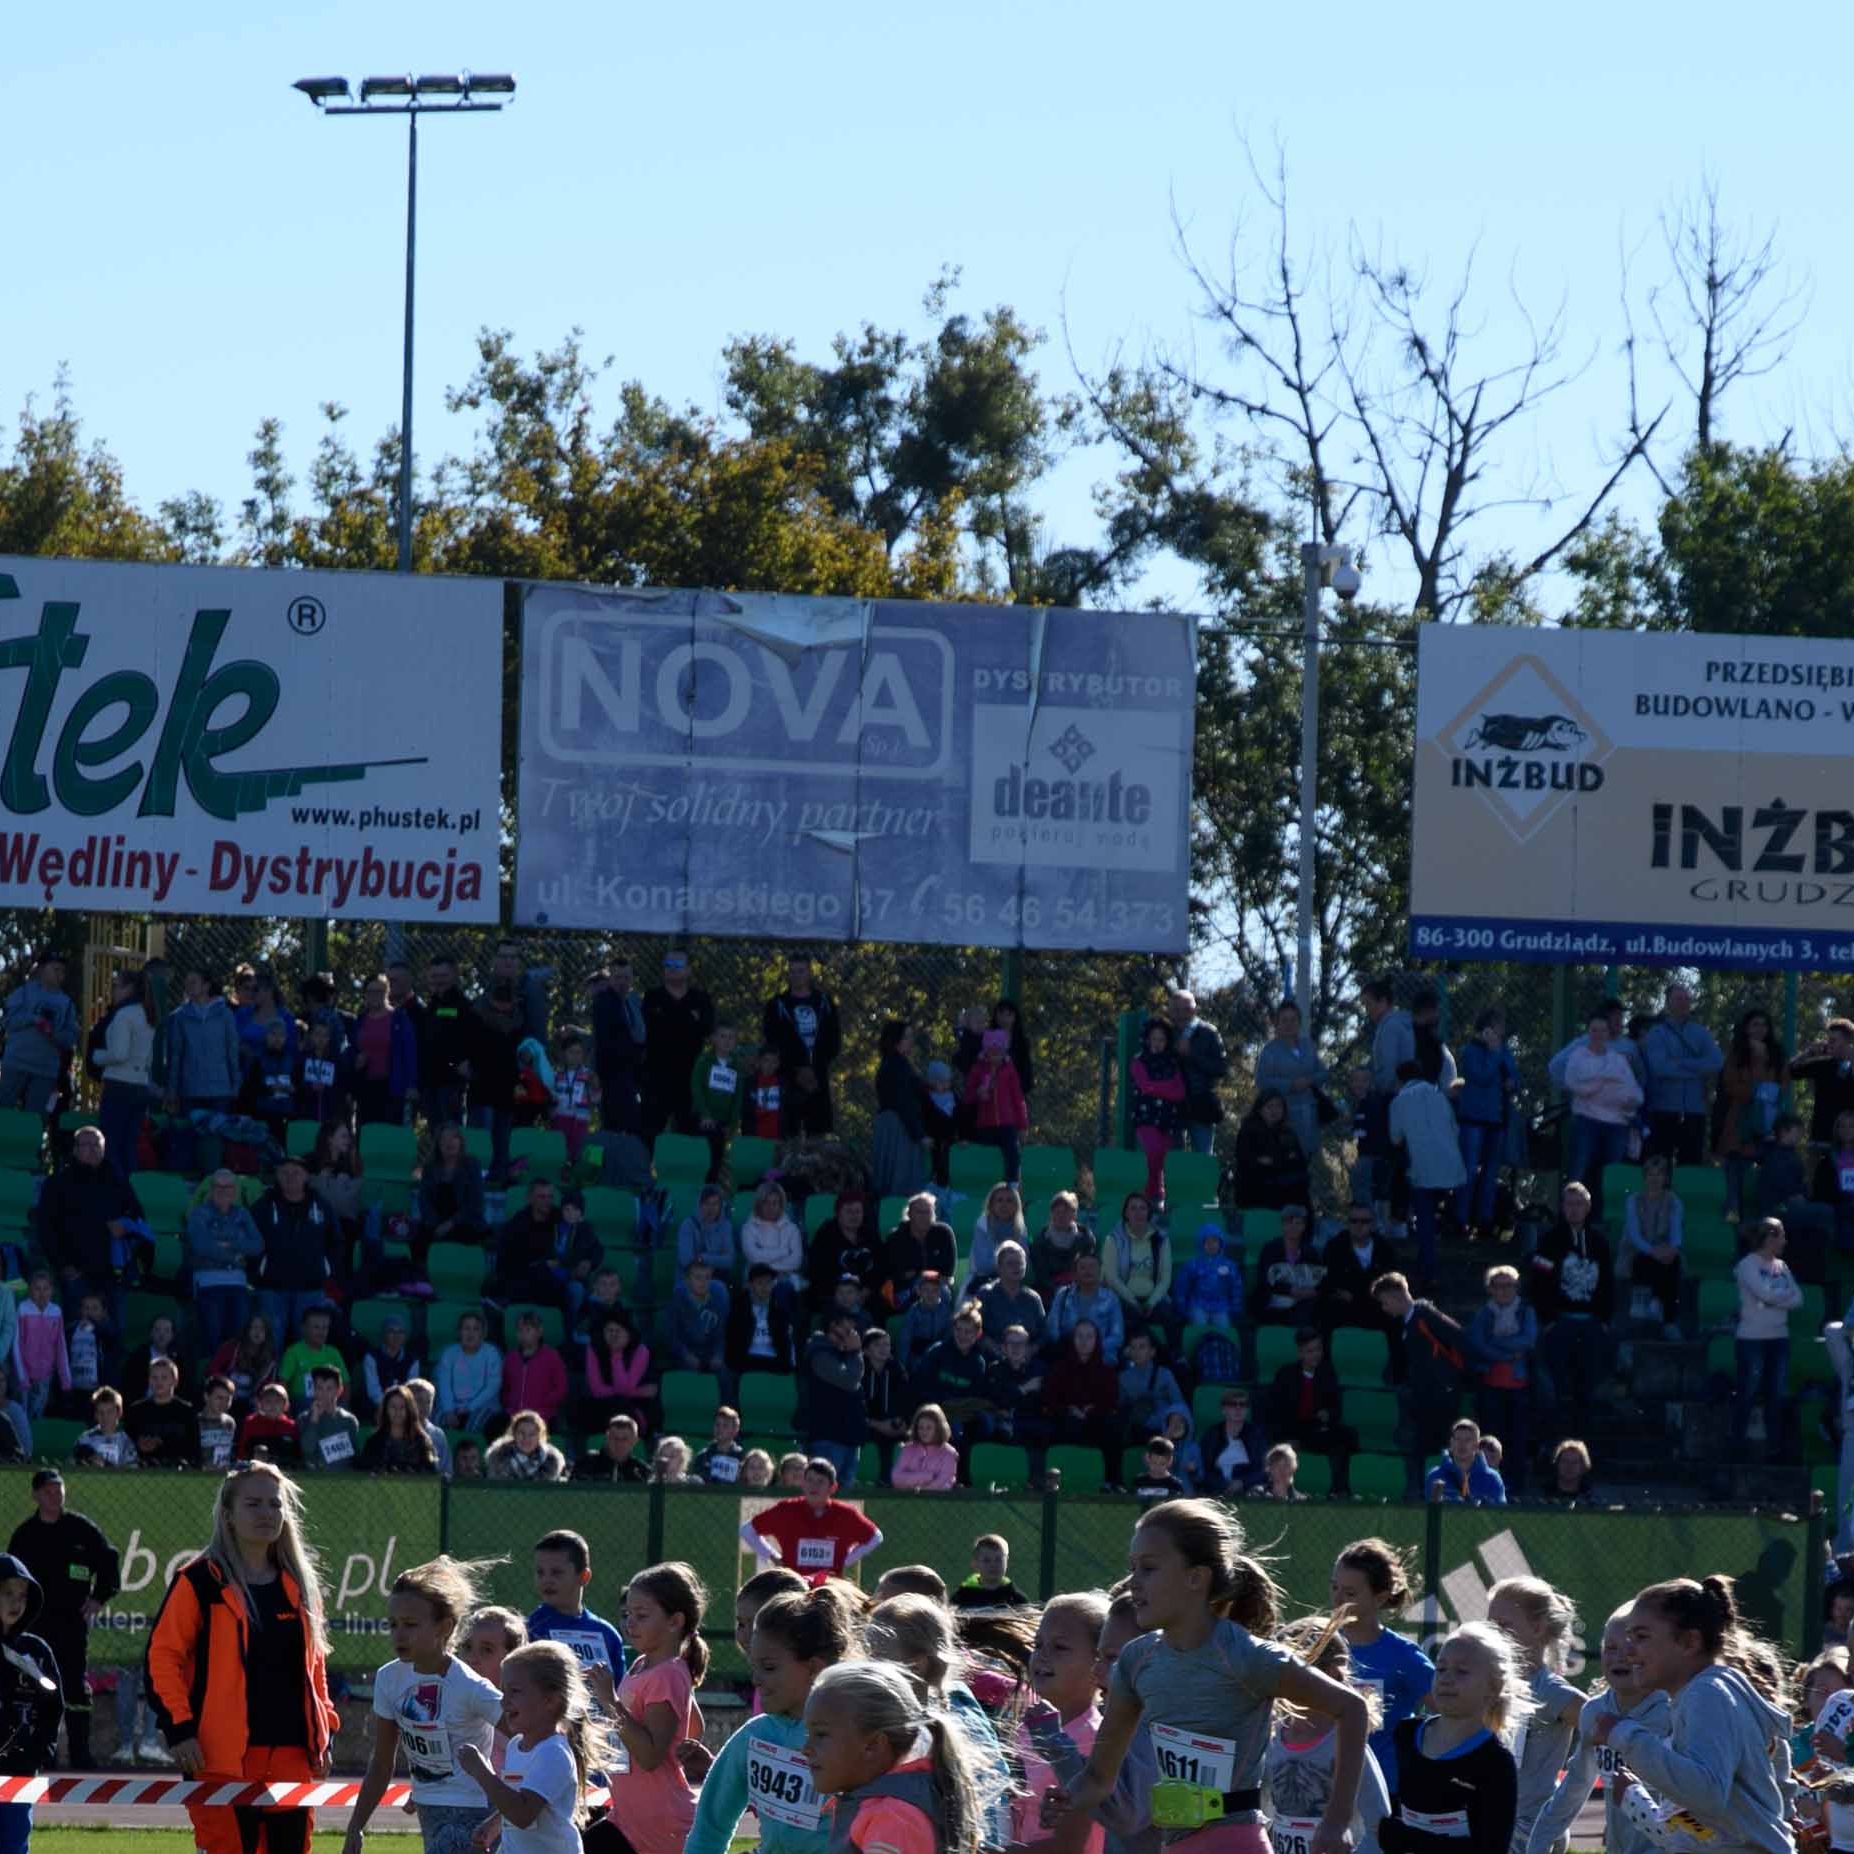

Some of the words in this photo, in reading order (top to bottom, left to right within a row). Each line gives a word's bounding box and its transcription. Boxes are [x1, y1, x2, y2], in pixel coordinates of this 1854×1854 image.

[561, 637, 931, 747] NOVA
[973, 668, 1183, 697] DYSRYBUTOR
[1635, 693, 1814, 722] BUDOWLANO
[995, 762, 1151, 824] deante
[1451, 753, 1604, 792] INŻBUD
[291, 806, 481, 835] www.phustek.pl
[209, 840, 482, 910] Dystrybucja
[596, 876, 841, 920] Konarskiego
[1417, 926, 1494, 948] 86-300
[1500, 930, 1617, 956] Grudziądz,
[750, 1760, 803, 1804] 3943
